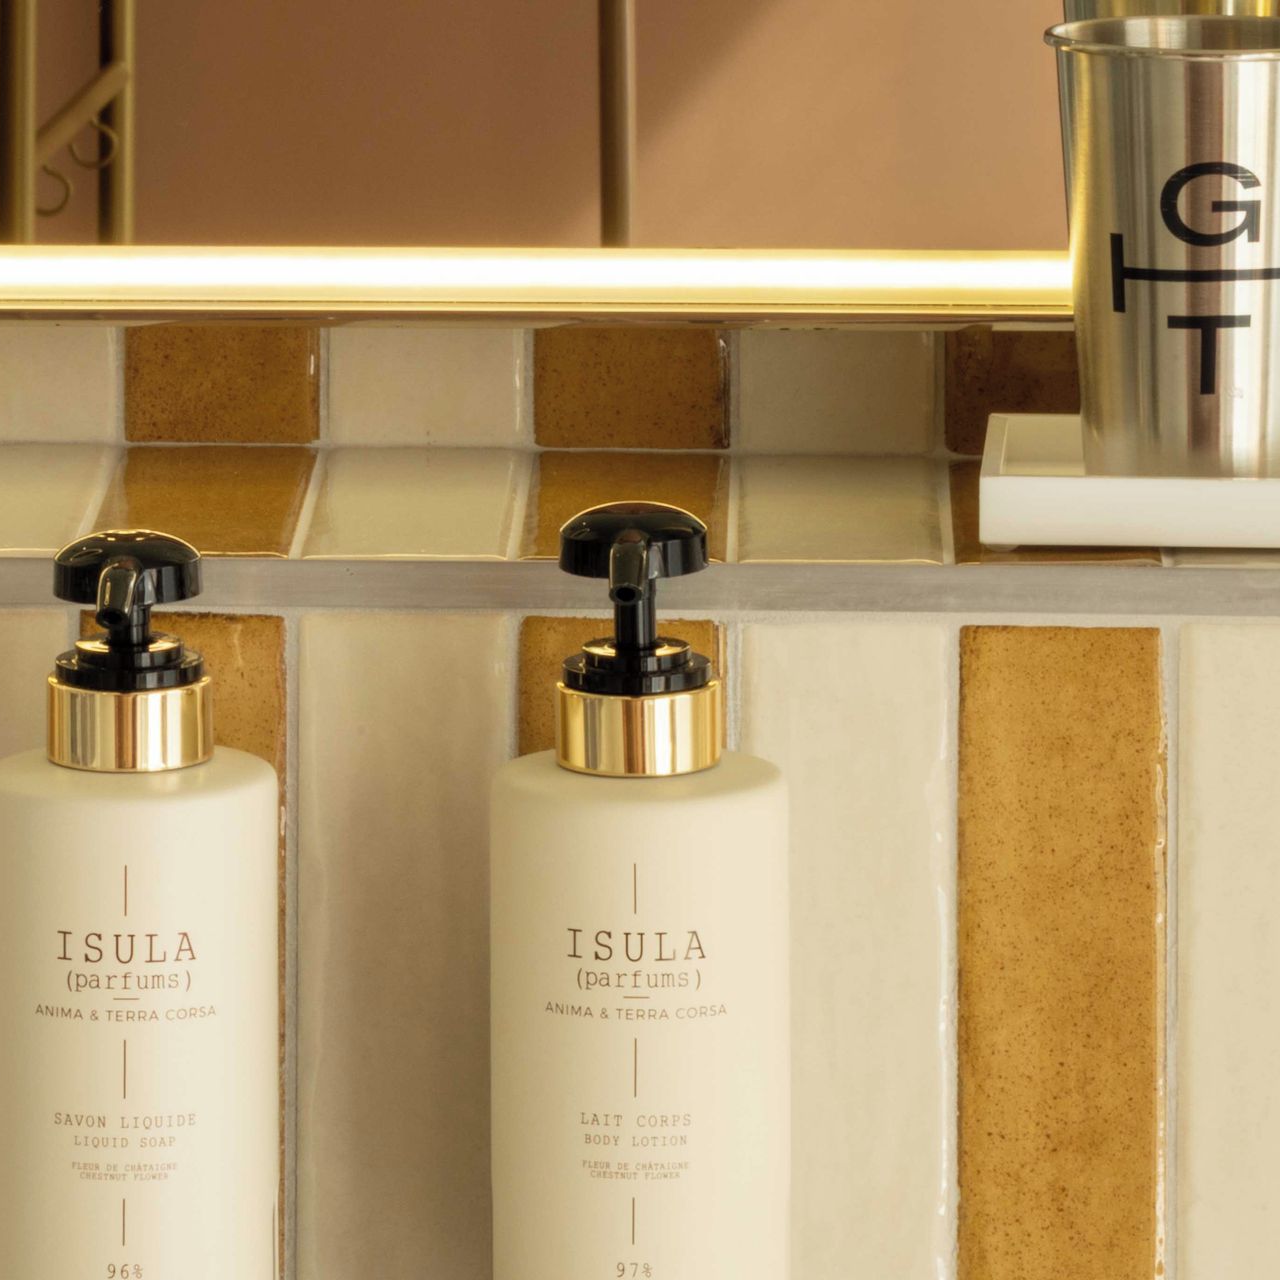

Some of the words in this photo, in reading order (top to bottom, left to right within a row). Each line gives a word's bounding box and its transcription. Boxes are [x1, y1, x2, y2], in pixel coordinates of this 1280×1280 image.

[56, 929, 198, 965] ISULA
[566, 927, 708, 963] ISULA
[65, 969, 193, 993] (parfums)
[575, 967, 703, 991] (parfums)
[34, 1003, 84, 1021] ANIMA
[89, 1008, 100, 1022] &
[106, 1008, 160, 1023] TERRA
[165, 1005, 218, 1021] CORSA
[545, 1001, 594, 1019] ANIMA
[599, 1007, 610, 1020] &
[616, 1007, 670, 1021] TERRA
[675, 1004, 728, 1020] CORSA
[54, 1112, 107, 1128] SAVON
[120, 1113, 197, 1130] LIQUIDE
[580, 1112, 623, 1127] LAIT
[636, 1113, 692, 1128] CORPS
[73, 1135, 130, 1149] LIQUID
[139, 1136, 177, 1148] SOAP
[584, 1133, 620, 1147] BODY
[631, 1135, 688, 1147] LOTION
[71, 1161, 100, 1171] FLEUR
[105, 1163, 118, 1172] DE
[582, 1160, 611, 1170] FLEUR
[617, 1162, 629, 1171] DE
[79, 1171, 127, 1181] CHESTNUT
[133, 1172, 169, 1181] FLOWER
[590, 1170, 637, 1180] CHESTNUT
[644, 1171, 681, 1180] FLOWER
[107, 1263, 144, 1280] 96%
[616, 1261, 654, 1279] 97%
